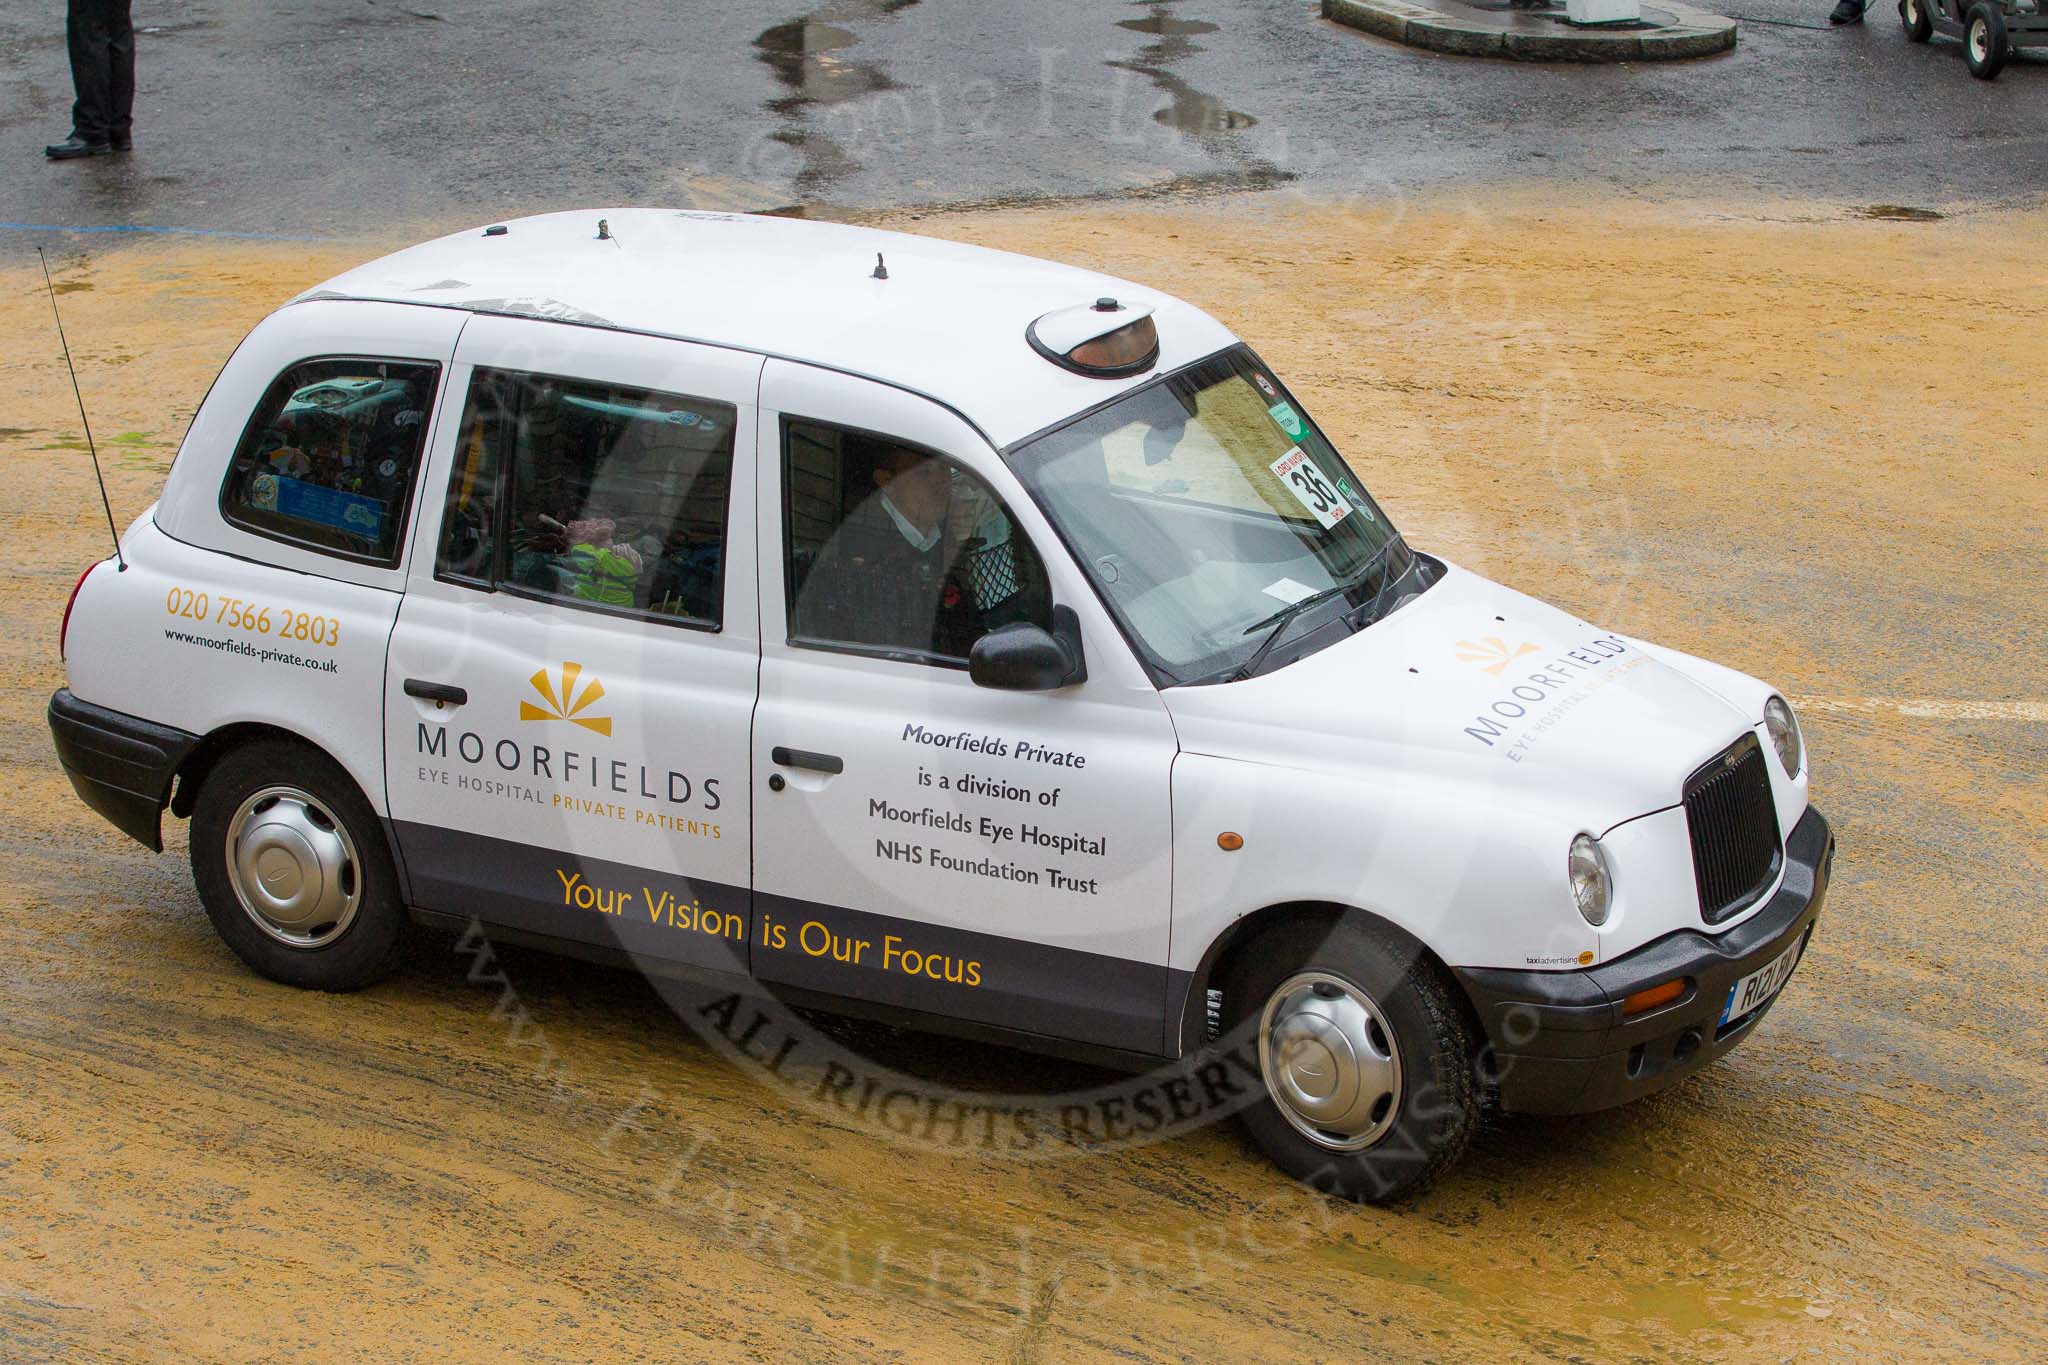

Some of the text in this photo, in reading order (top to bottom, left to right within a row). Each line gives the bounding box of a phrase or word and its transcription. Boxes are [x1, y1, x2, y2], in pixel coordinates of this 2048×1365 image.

[1291, 464, 1338, 513] 36
[166, 586, 340, 647] 020 7566 2803
[165, 629, 338, 674] www.moorfields-private.co.uk
[418, 723, 721, 811] MOORFIELDS
[902, 723, 1086, 769] Moorfields Private
[1506, 732, 1537, 762] EYE
[418, 767, 721, 839] EYE HOSPITAL PRIVATE PATIENTS
[918, 766, 1061, 807] is a division of
[869, 798, 1106, 856] Moorfields Eye Hospital
[876, 839, 1098, 895] NHS Foundation Trust
[556, 869, 982, 987] Your Vision is Our Focus
